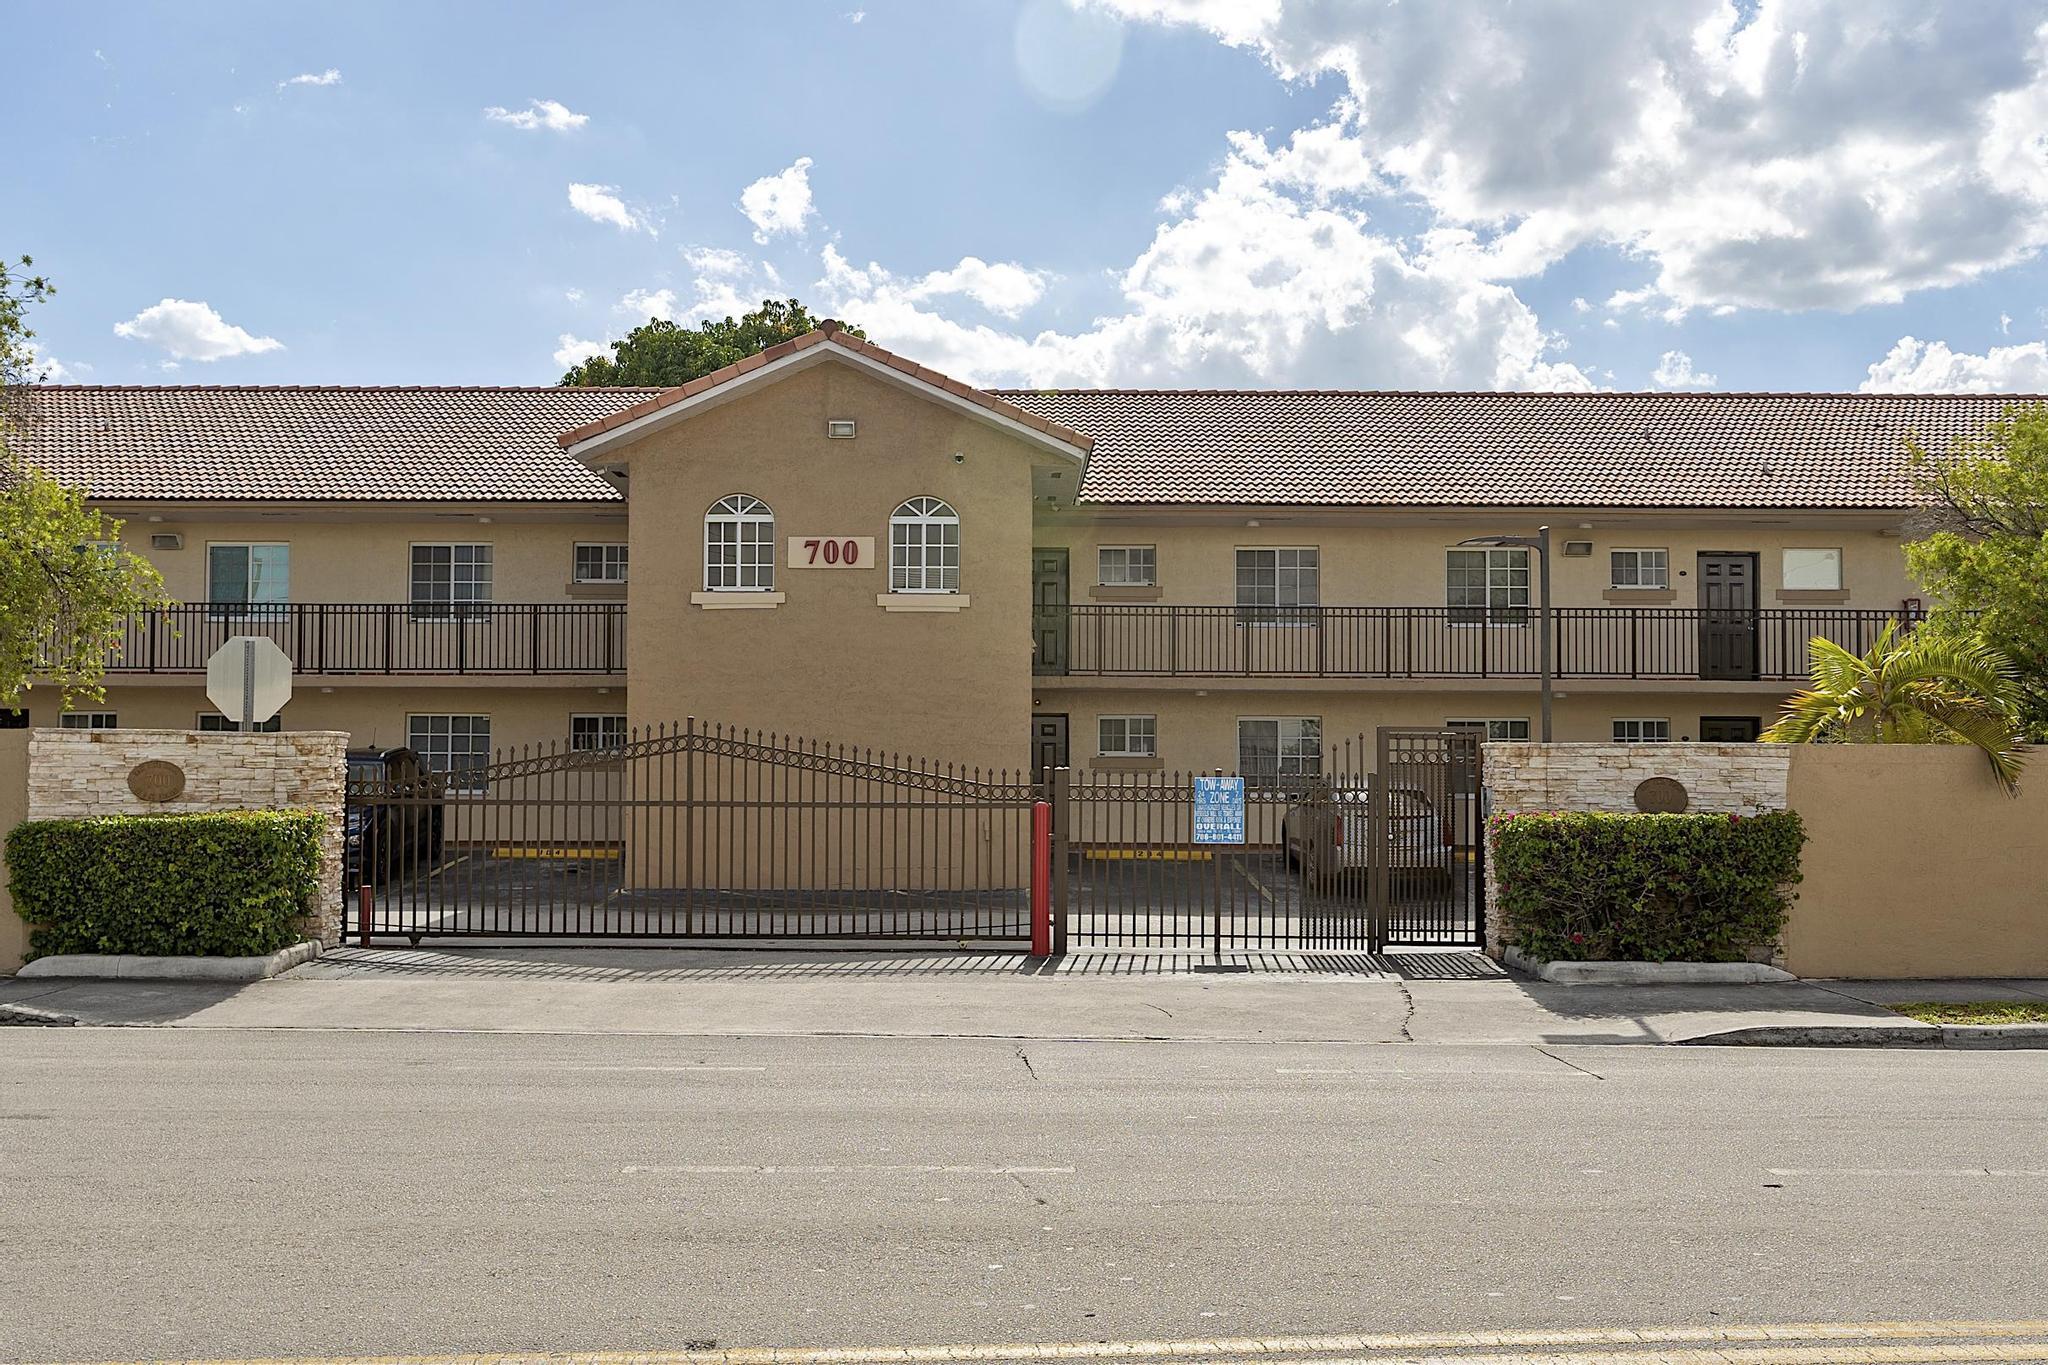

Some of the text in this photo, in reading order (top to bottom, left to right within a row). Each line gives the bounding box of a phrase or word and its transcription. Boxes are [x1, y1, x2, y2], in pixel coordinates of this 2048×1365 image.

[804, 540, 858, 565] 700
[1200, 779, 1239, 791] TOW-AWAY
[1210, 792, 1229, 804] ZONE
